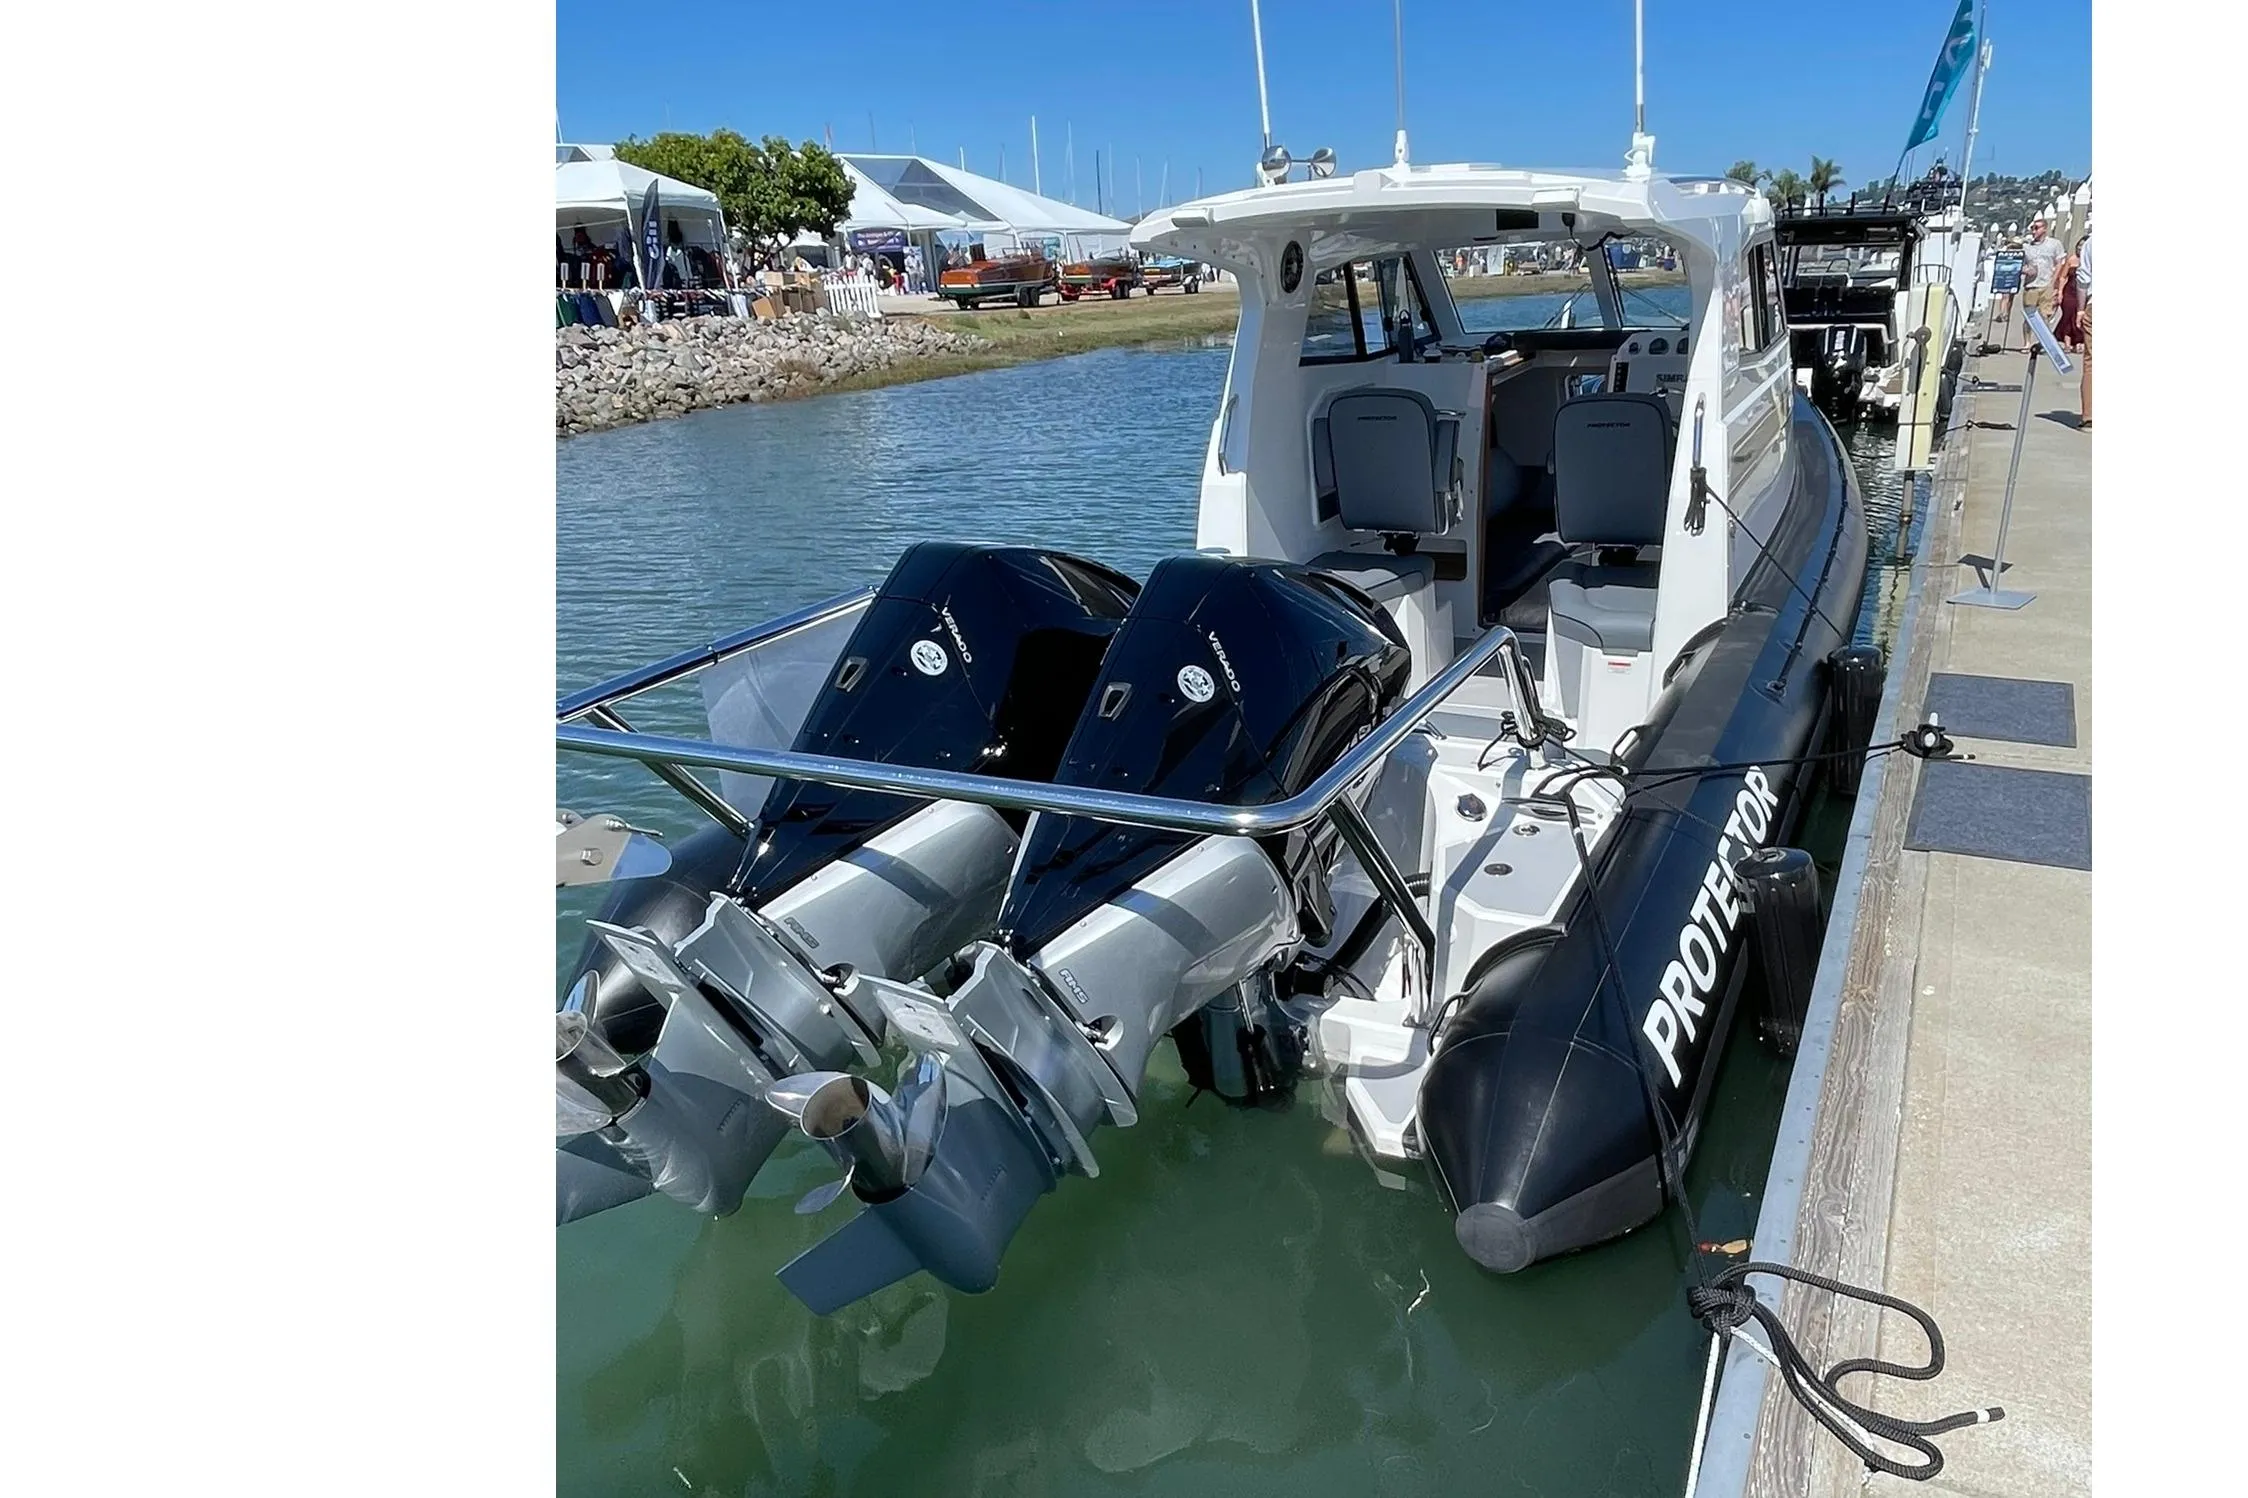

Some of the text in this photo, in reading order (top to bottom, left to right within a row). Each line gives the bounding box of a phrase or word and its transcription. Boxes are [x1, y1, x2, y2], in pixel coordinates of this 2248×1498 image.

[1656, 374, 1687, 382] SIMR
[941, 606, 972, 663] VERADO
[1208, 631, 1241, 692] VERADO
[1642, 765, 1778, 1088] PROTECTOR
